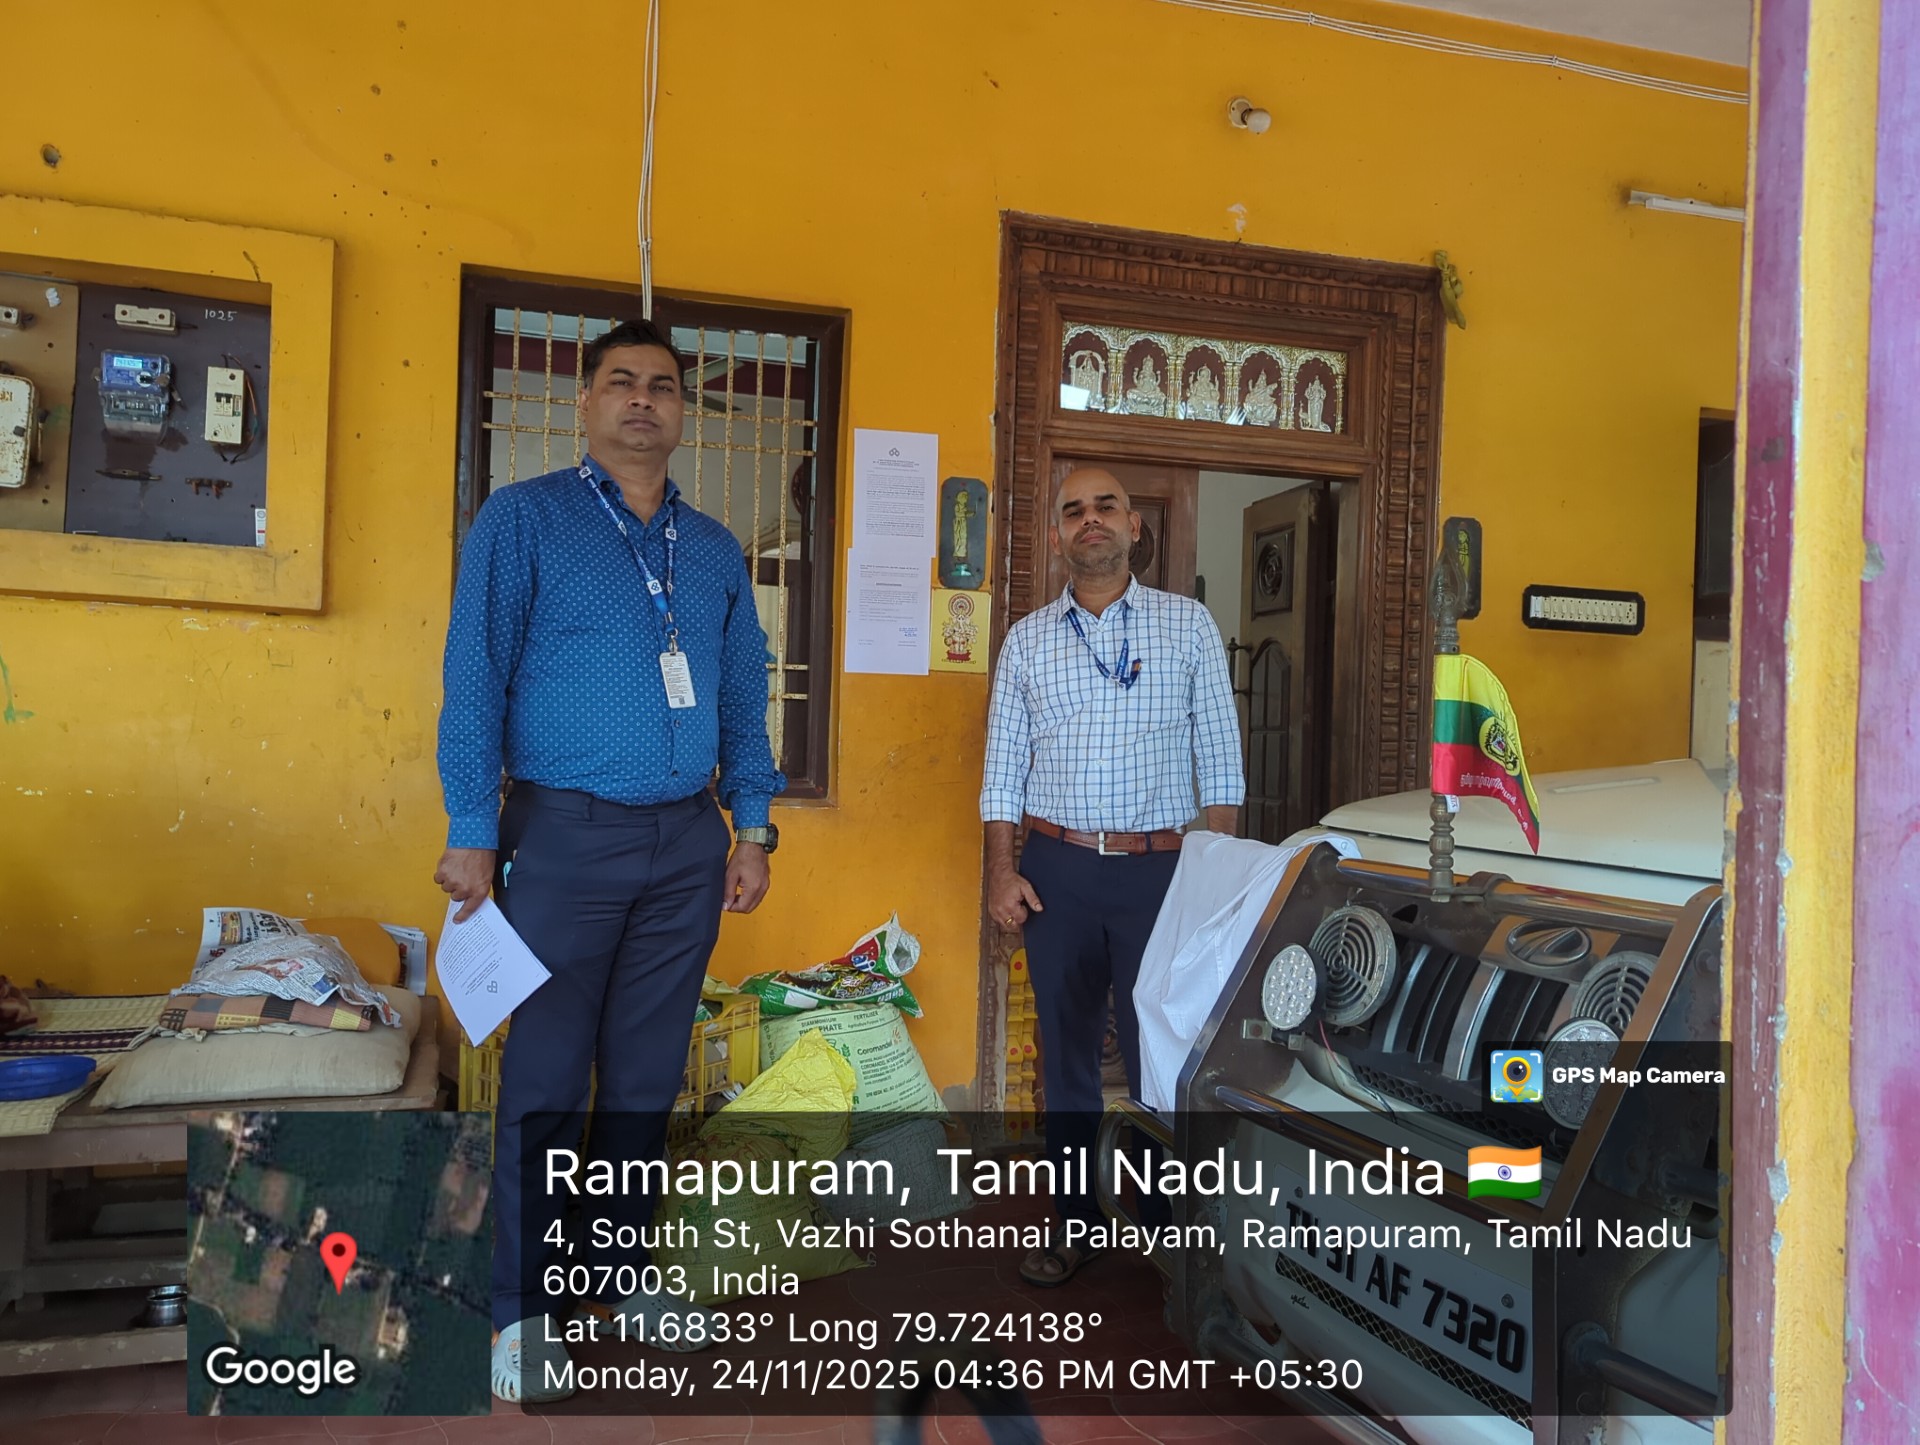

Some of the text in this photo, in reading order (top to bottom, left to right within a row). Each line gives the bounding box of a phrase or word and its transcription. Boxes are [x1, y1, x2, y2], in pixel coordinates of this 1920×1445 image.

[205, 308, 238, 322] 1025
[1285, 1201, 1527, 1374] TN 31 AF 7320
